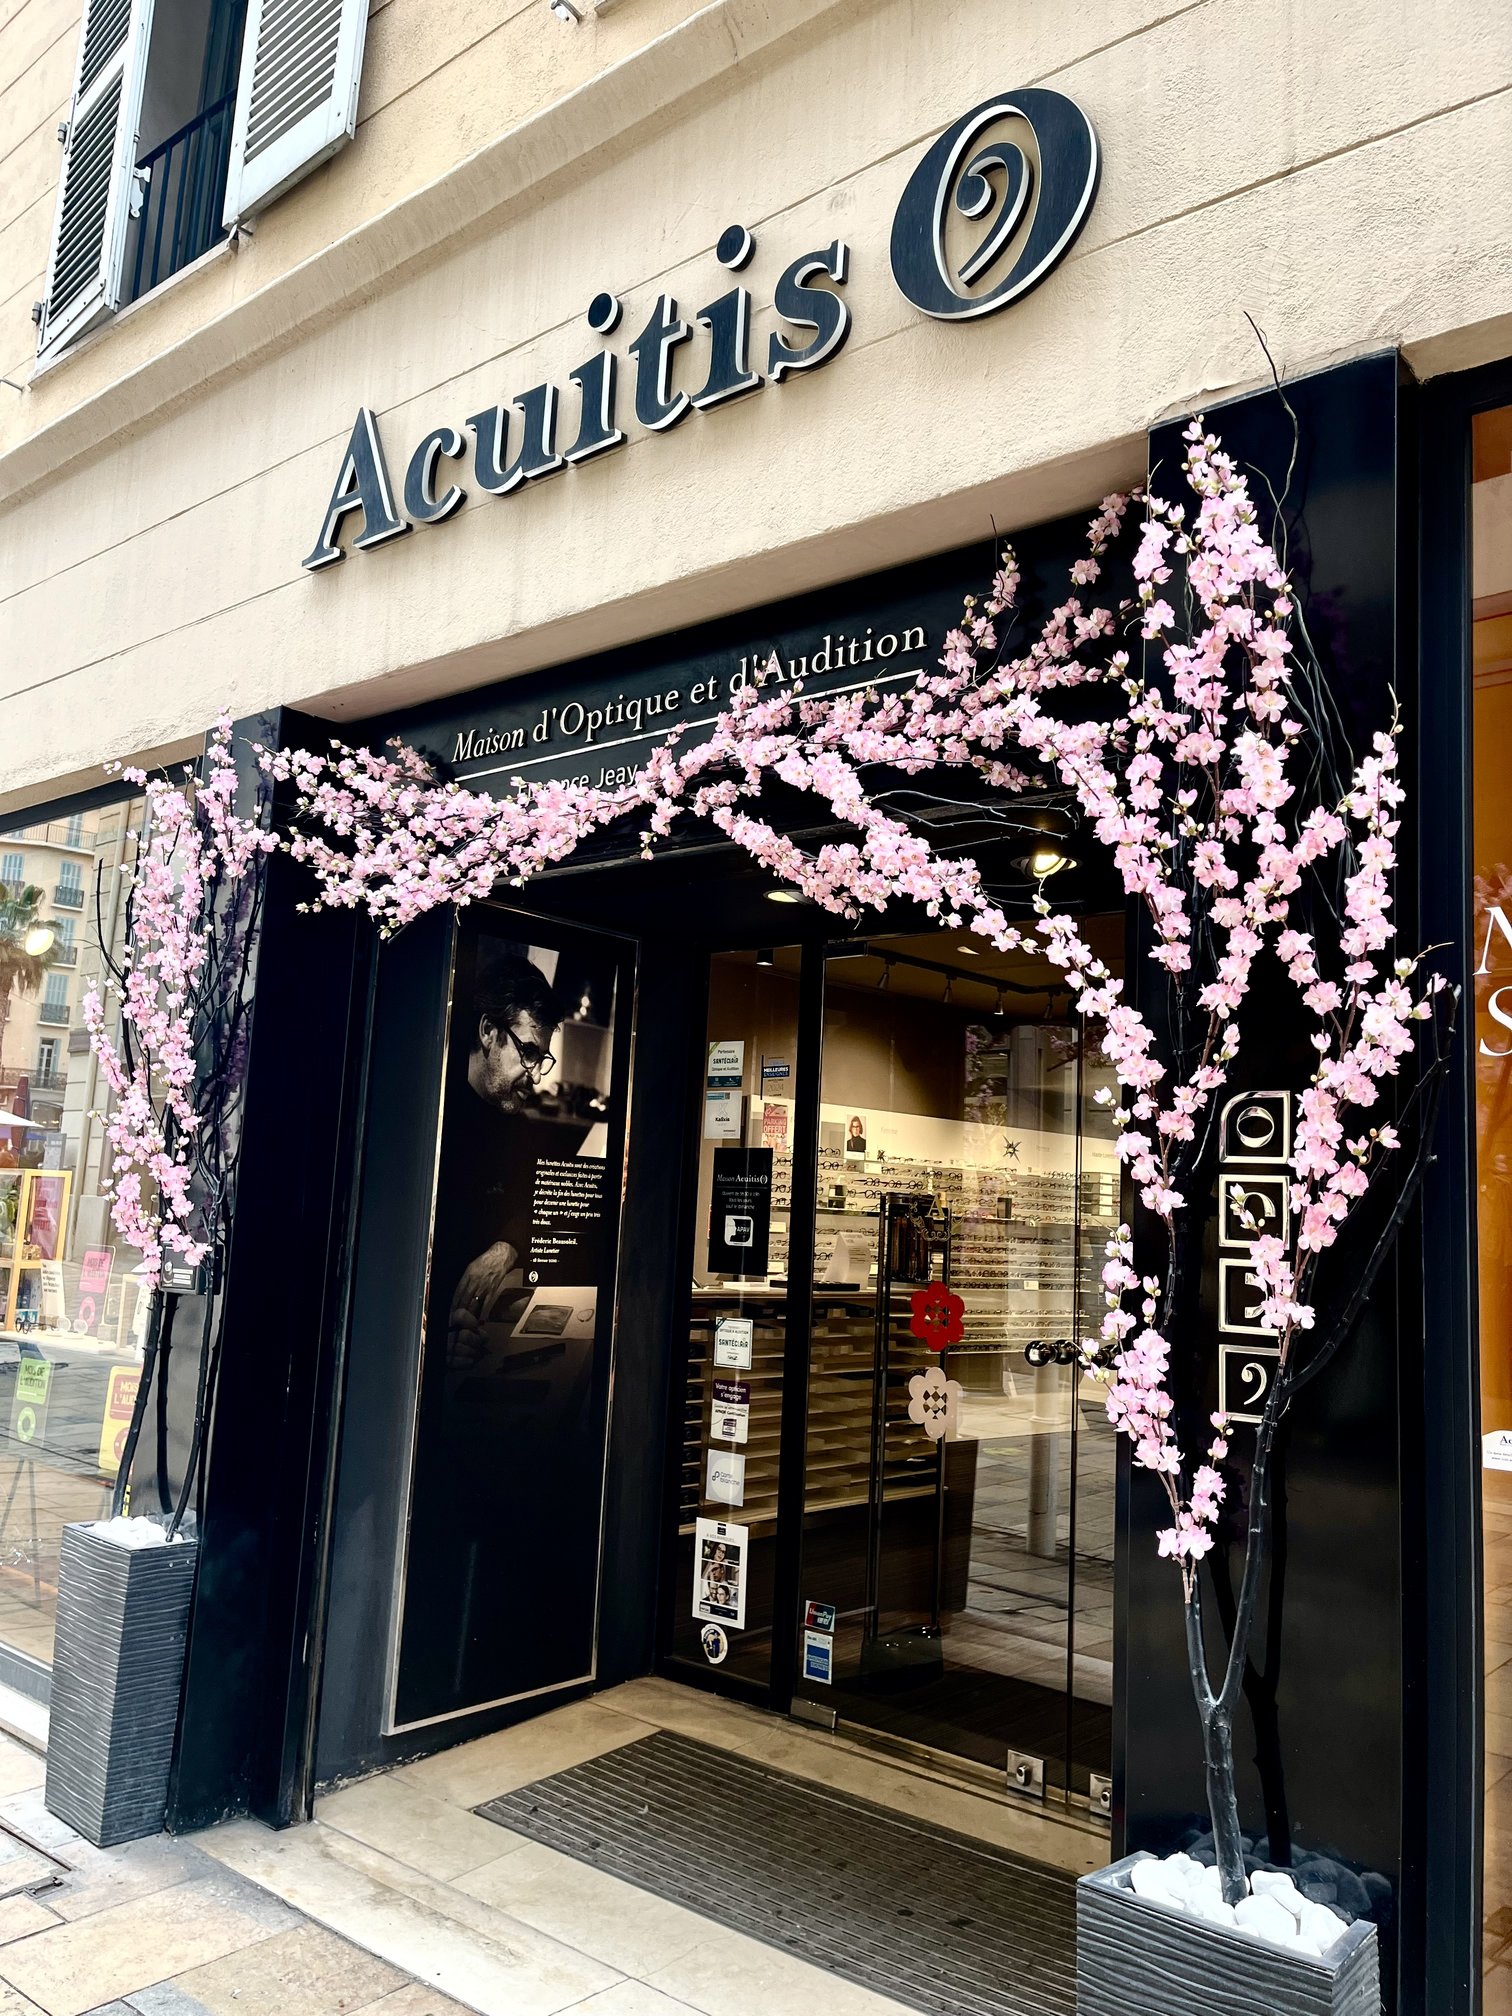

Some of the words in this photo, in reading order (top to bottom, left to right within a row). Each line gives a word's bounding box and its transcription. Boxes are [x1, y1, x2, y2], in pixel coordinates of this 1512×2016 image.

[302, 223, 851, 572] Acuitis
[451, 727, 525, 763] Maison
[532, 689, 679, 743] d'Optique
[690, 675, 718, 704] et
[729, 626, 927, 695] d'Audition
[595, 764, 638, 789] Jeay
[735, 1174, 760, 1183] Acuitis
[120, 1381, 139, 1393] MOIS
